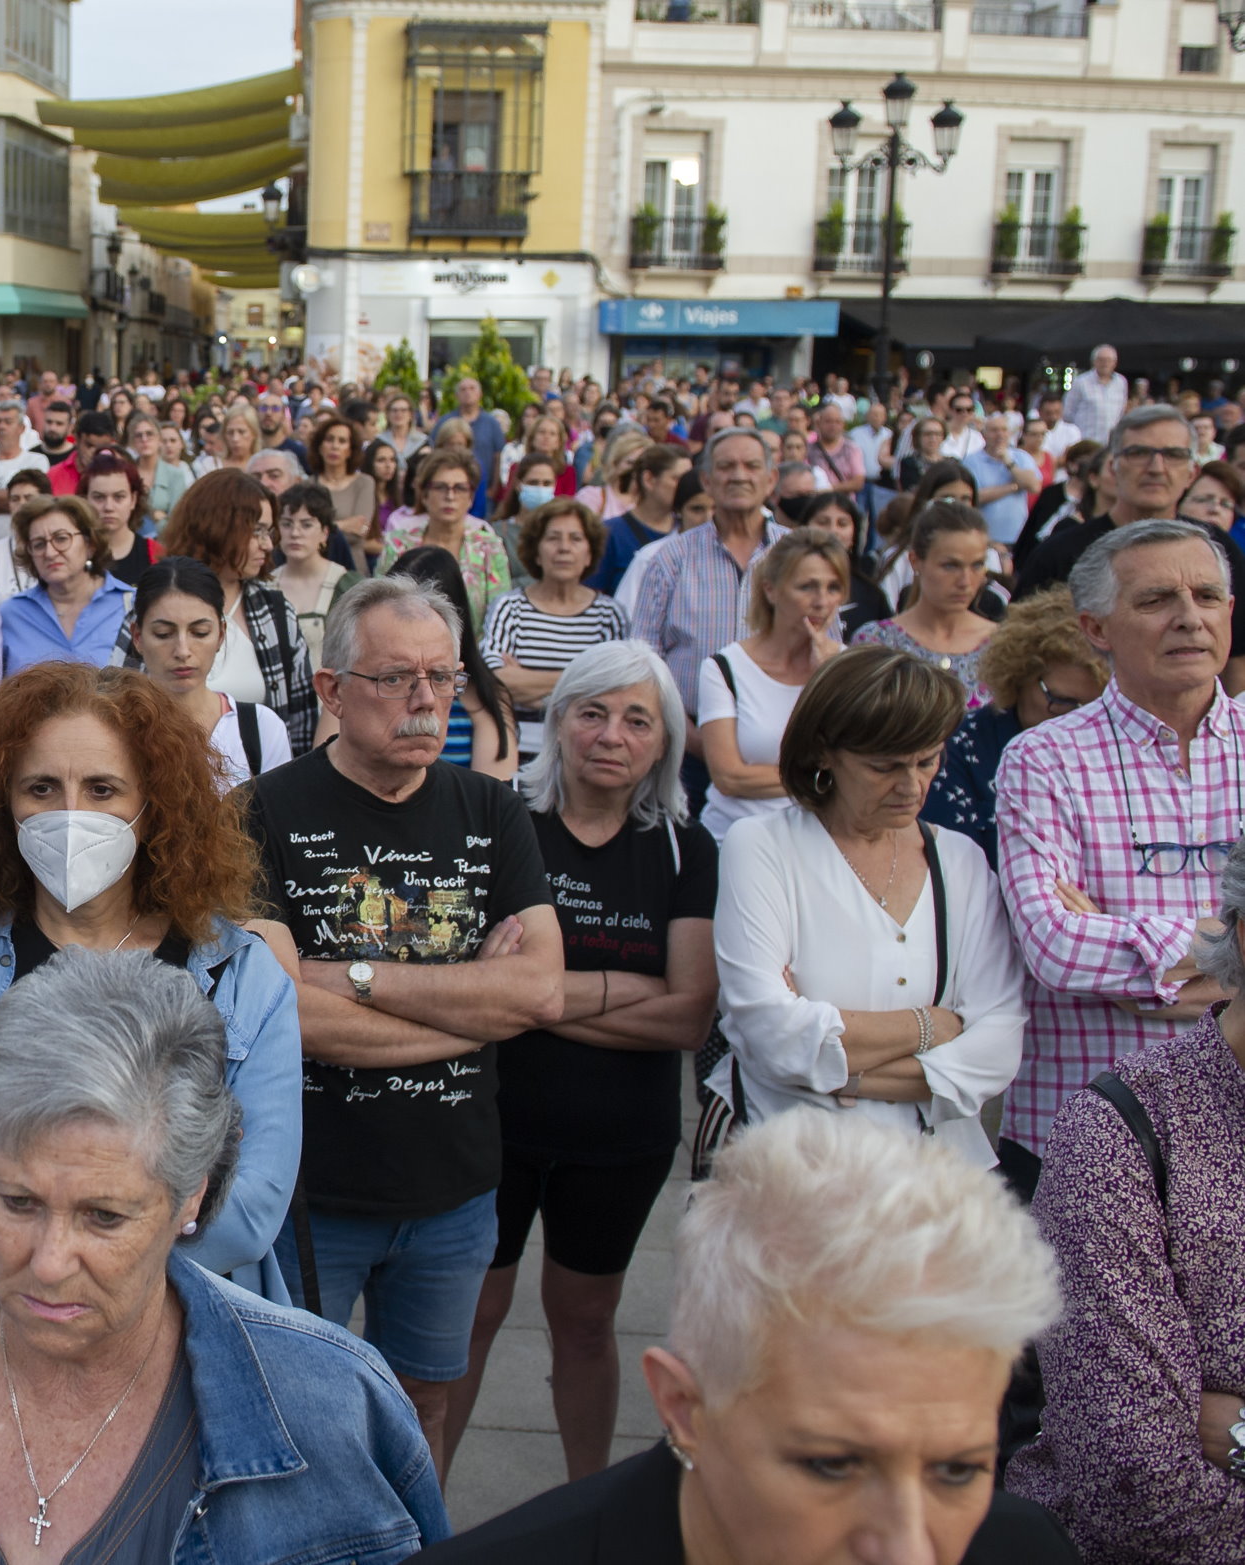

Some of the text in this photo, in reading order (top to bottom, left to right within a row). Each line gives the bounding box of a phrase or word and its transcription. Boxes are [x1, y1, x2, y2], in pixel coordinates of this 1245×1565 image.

[684, 305, 739, 328] Viajes
[552, 873, 591, 893] chicas
[557, 890, 603, 911] buenas
[575, 911, 653, 932] van al cielo,
[582, 930, 620, 951] todas
[386, 1076, 446, 1098] Degas
